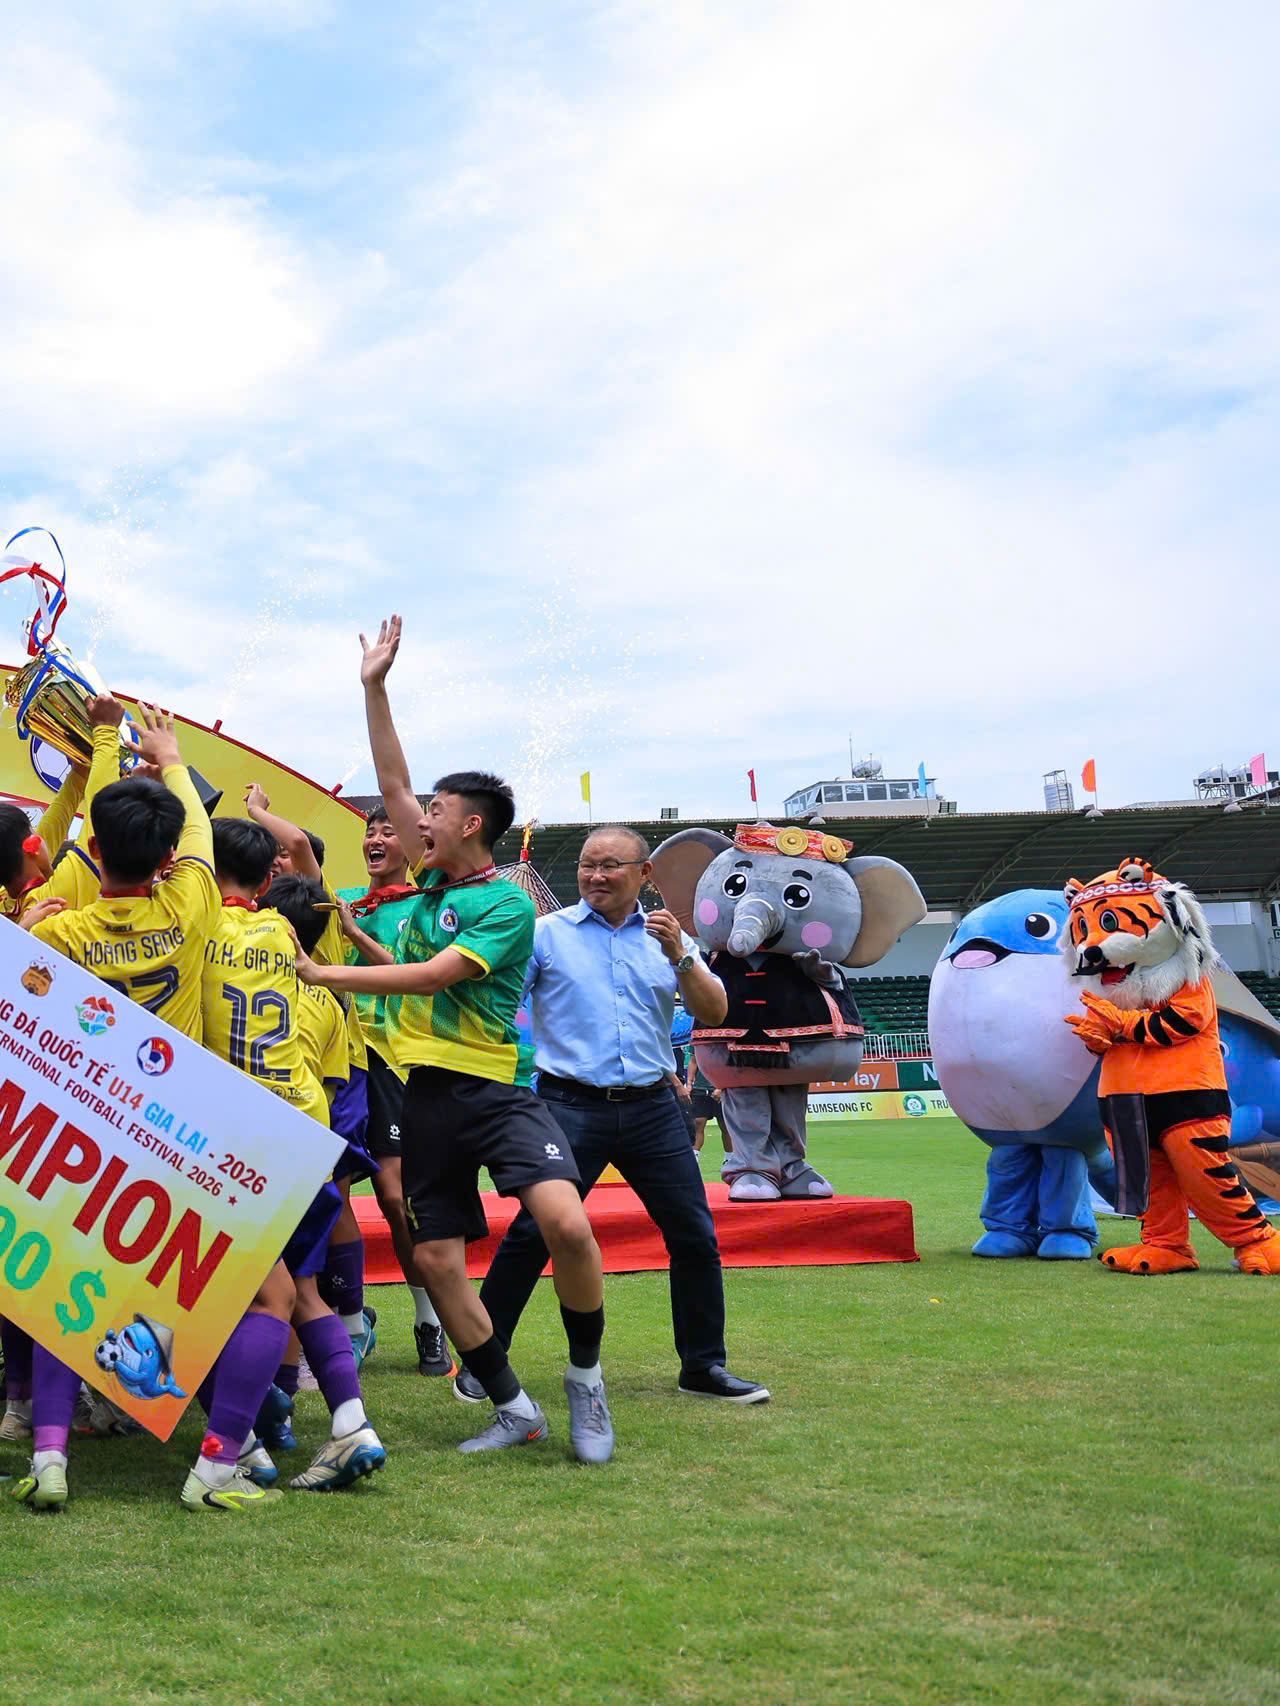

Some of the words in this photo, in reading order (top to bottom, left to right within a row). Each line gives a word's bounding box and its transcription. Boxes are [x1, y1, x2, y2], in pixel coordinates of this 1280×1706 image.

[83, 940, 137, 967] HOÀNG
[140, 926, 185, 959] SANG
[100, 965, 180, 1016] 7
[222, 982, 291, 1083] 12
[15, 1004, 40, 1038] ĐÁ
[38, 1030, 84, 1069] QUỐC
[84, 1059, 116, 1087] TẾ
[108, 1076, 144, 1110] U14
[144, 1102, 175, 1134] GIA
[175, 1122, 208, 1155] LAI
[217, 1153, 268, 1195] 2026
[860, 1101, 873, 1112] FC
[63, 1079, 124, 1130] FOOTBALL
[126, 1123, 184, 1172] FESTIVAL
[187, 1165, 224, 1197] 2026
[54, 1269, 107, 1336] $
